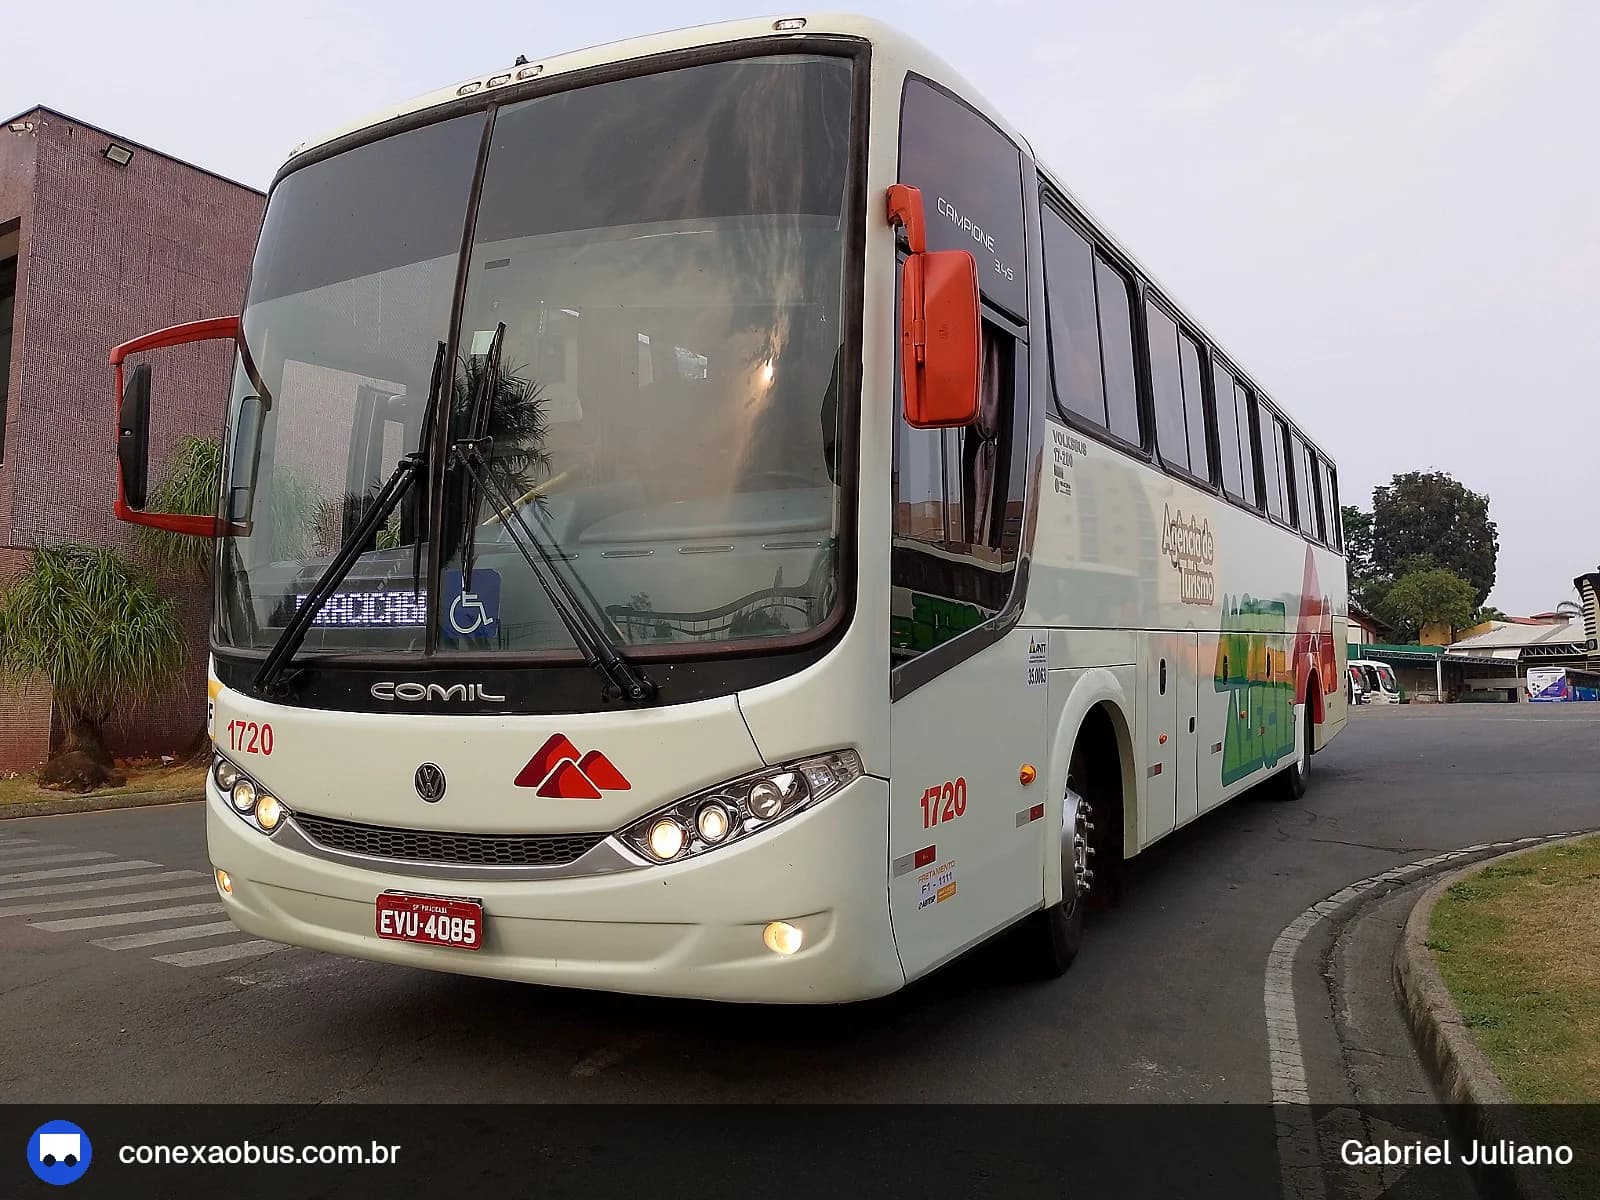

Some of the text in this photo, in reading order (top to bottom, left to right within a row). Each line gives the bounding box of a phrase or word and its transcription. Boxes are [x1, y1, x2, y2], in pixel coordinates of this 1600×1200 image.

[937, 197, 995, 254] CAMPIONE
[1052, 429, 1087, 457] VOLKSBUS
[1178, 558, 1214, 606] Turismo
[370, 682, 506, 701] COMIL
[227, 719, 274, 756] 1720
[920, 776, 967, 829] 1720
